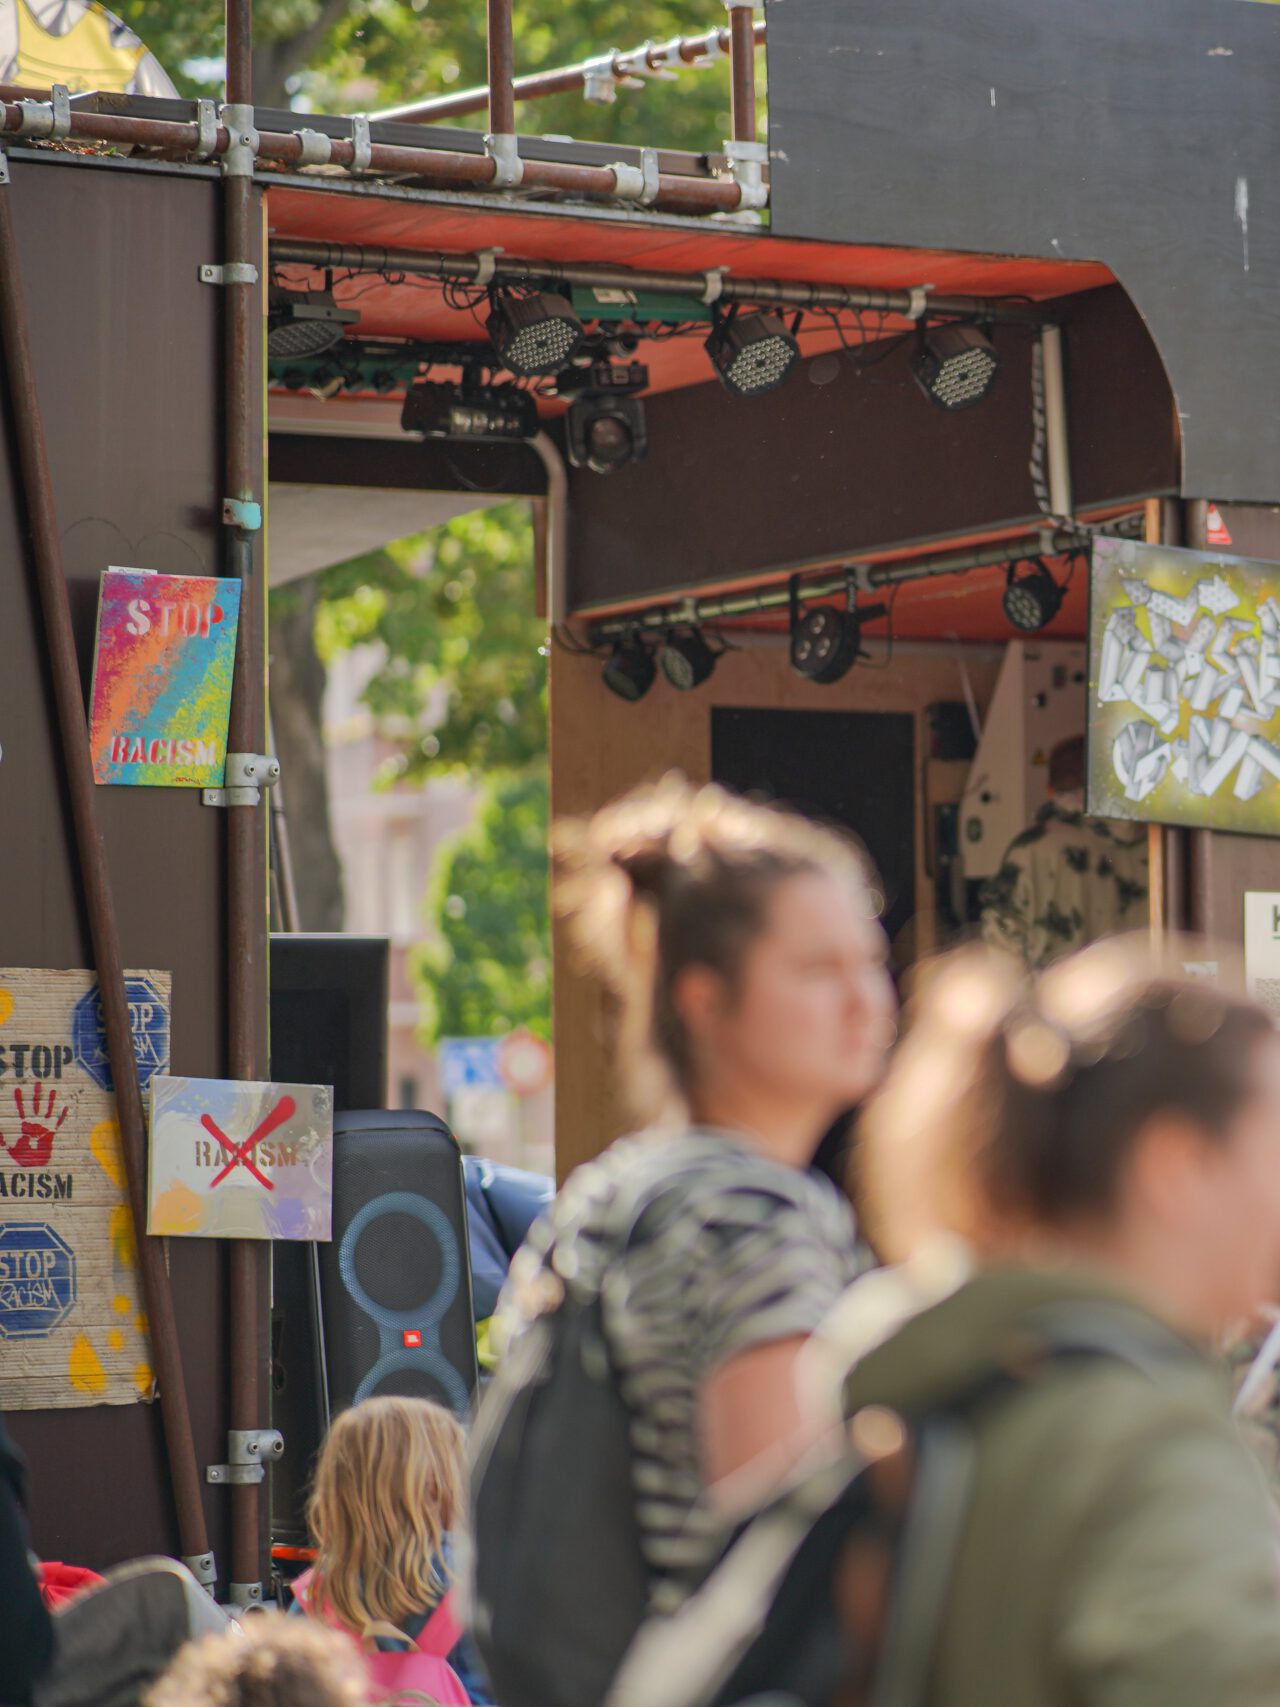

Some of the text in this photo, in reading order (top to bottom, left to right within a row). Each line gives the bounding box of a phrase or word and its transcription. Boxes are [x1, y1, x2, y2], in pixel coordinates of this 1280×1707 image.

[127, 599, 224, 638] STOP
[111, 736, 216, 766] RACISM
[0, 1251, 56, 1279] STOP
